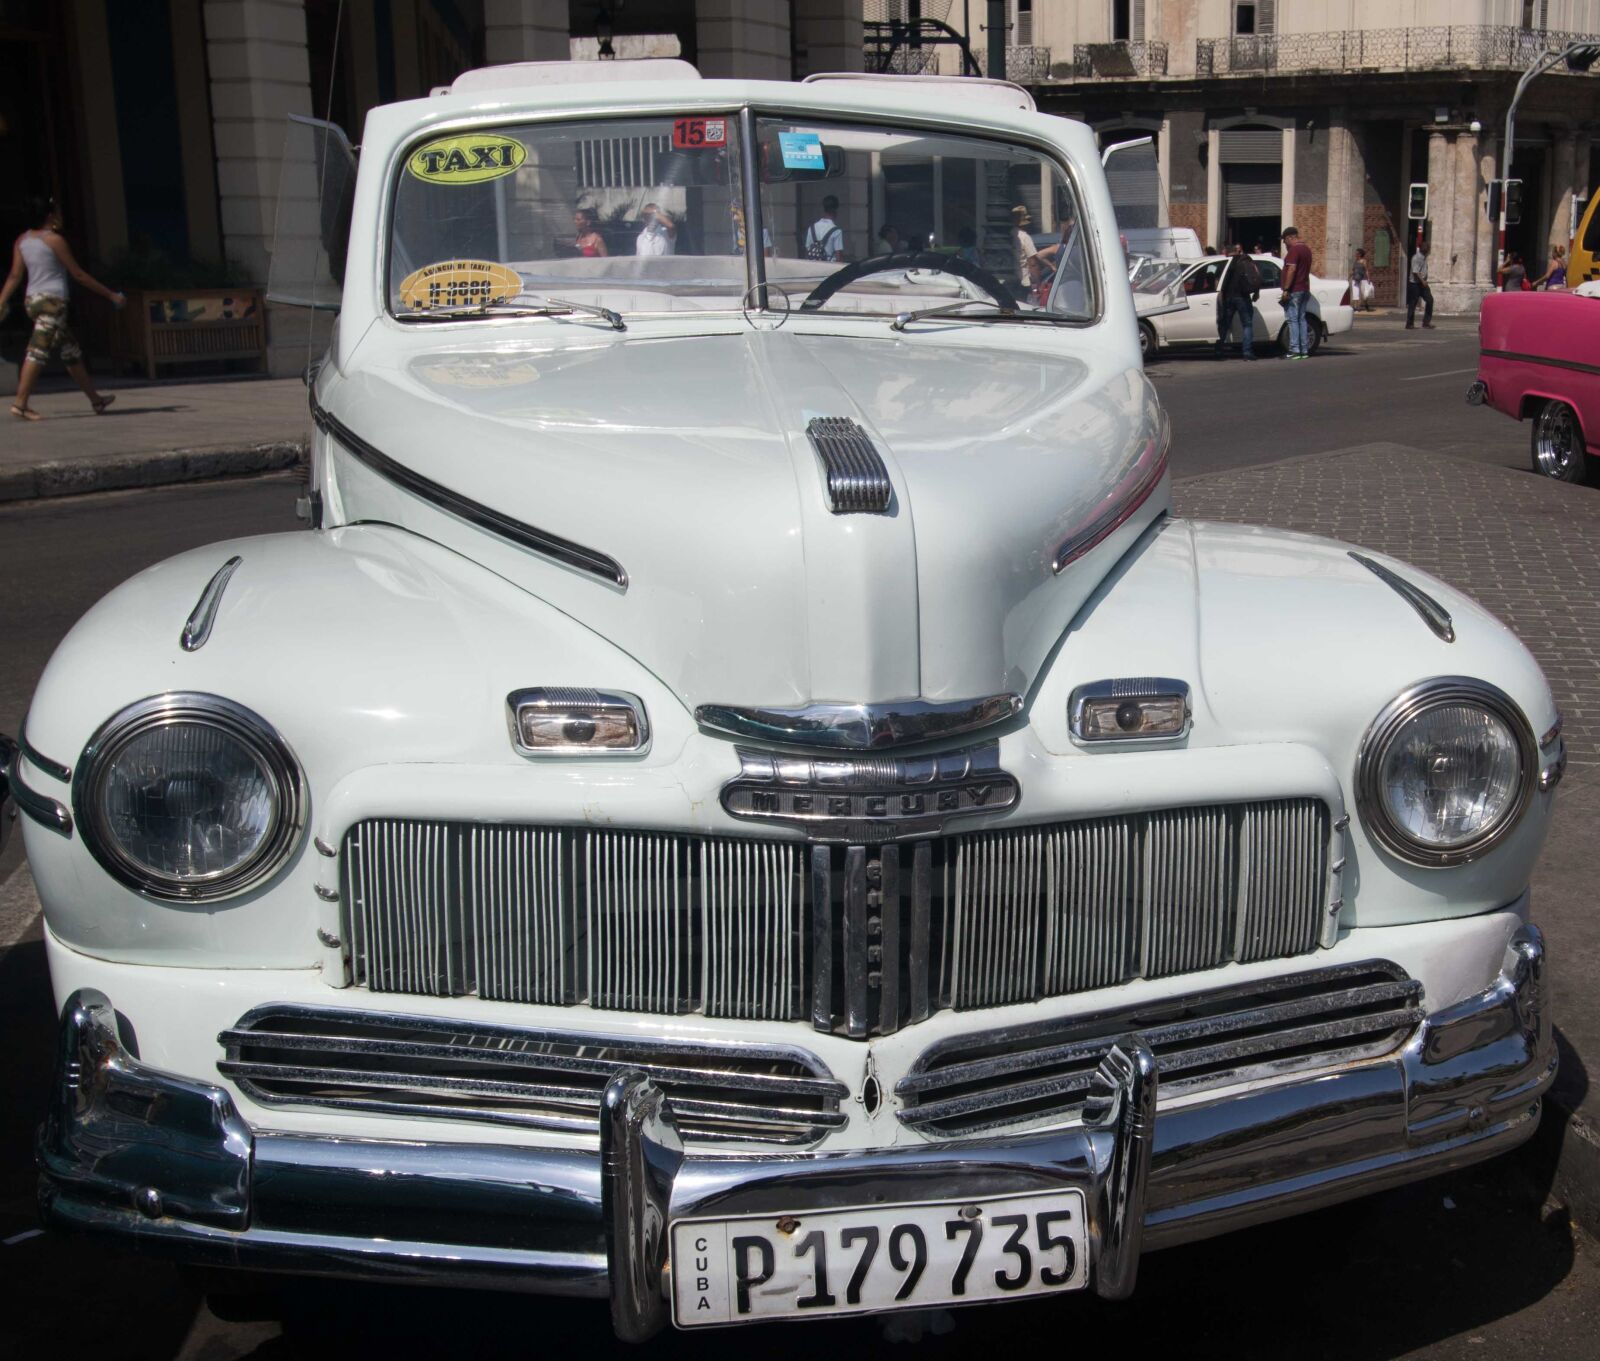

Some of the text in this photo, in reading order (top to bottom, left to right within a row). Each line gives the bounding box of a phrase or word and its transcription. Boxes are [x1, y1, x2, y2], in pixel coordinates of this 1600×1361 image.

[676, 120, 705, 145] 15
[419, 144, 515, 174] TAXI
[423, 263, 455, 277] AGENCIA
[752, 784, 991, 816] MERCURY
[866, 859, 883, 989] EIGHT
[695, 1237, 711, 1310] CUBA
[732, 1235, 775, 1314] P
